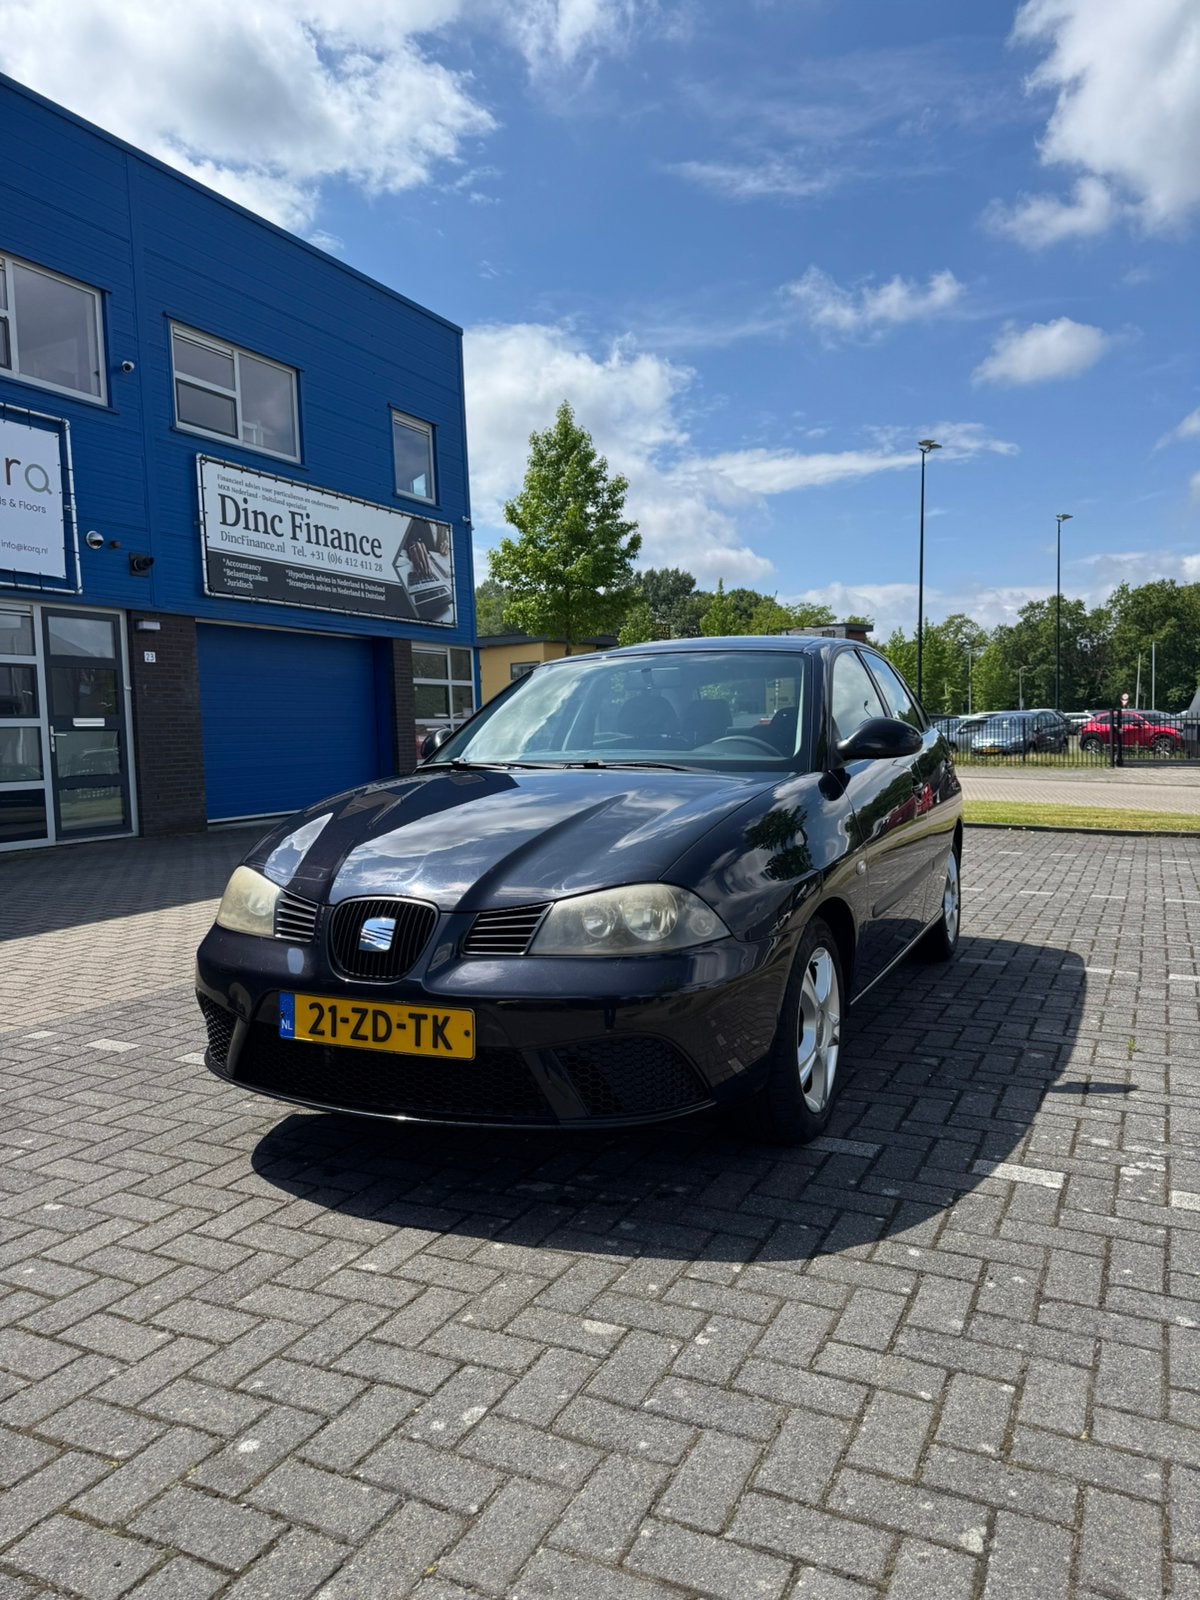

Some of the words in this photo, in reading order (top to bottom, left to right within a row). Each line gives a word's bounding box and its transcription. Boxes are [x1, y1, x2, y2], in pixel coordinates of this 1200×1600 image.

[231, 487, 258, 499] Nederland
[8, 498, 16, 508] &
[19, 500, 47, 514] Floors
[217, 493, 284, 538] Dinc
[288, 510, 383, 559] Finance
[1, 540, 48, 556] info@korq.nl
[220, 531, 286, 553] DincFinance.nl
[291, 545, 307, 558] Tel.
[310, 550, 324, 561] +31
[327, 551, 343, 564] (0)6
[345, 557, 359, 568] 412
[360, 560, 372, 570] 411
[374, 563, 383, 573] 28
[281, 1018, 293, 1031] NL
[308, 1002, 453, 1051] 21-ZD-TK
